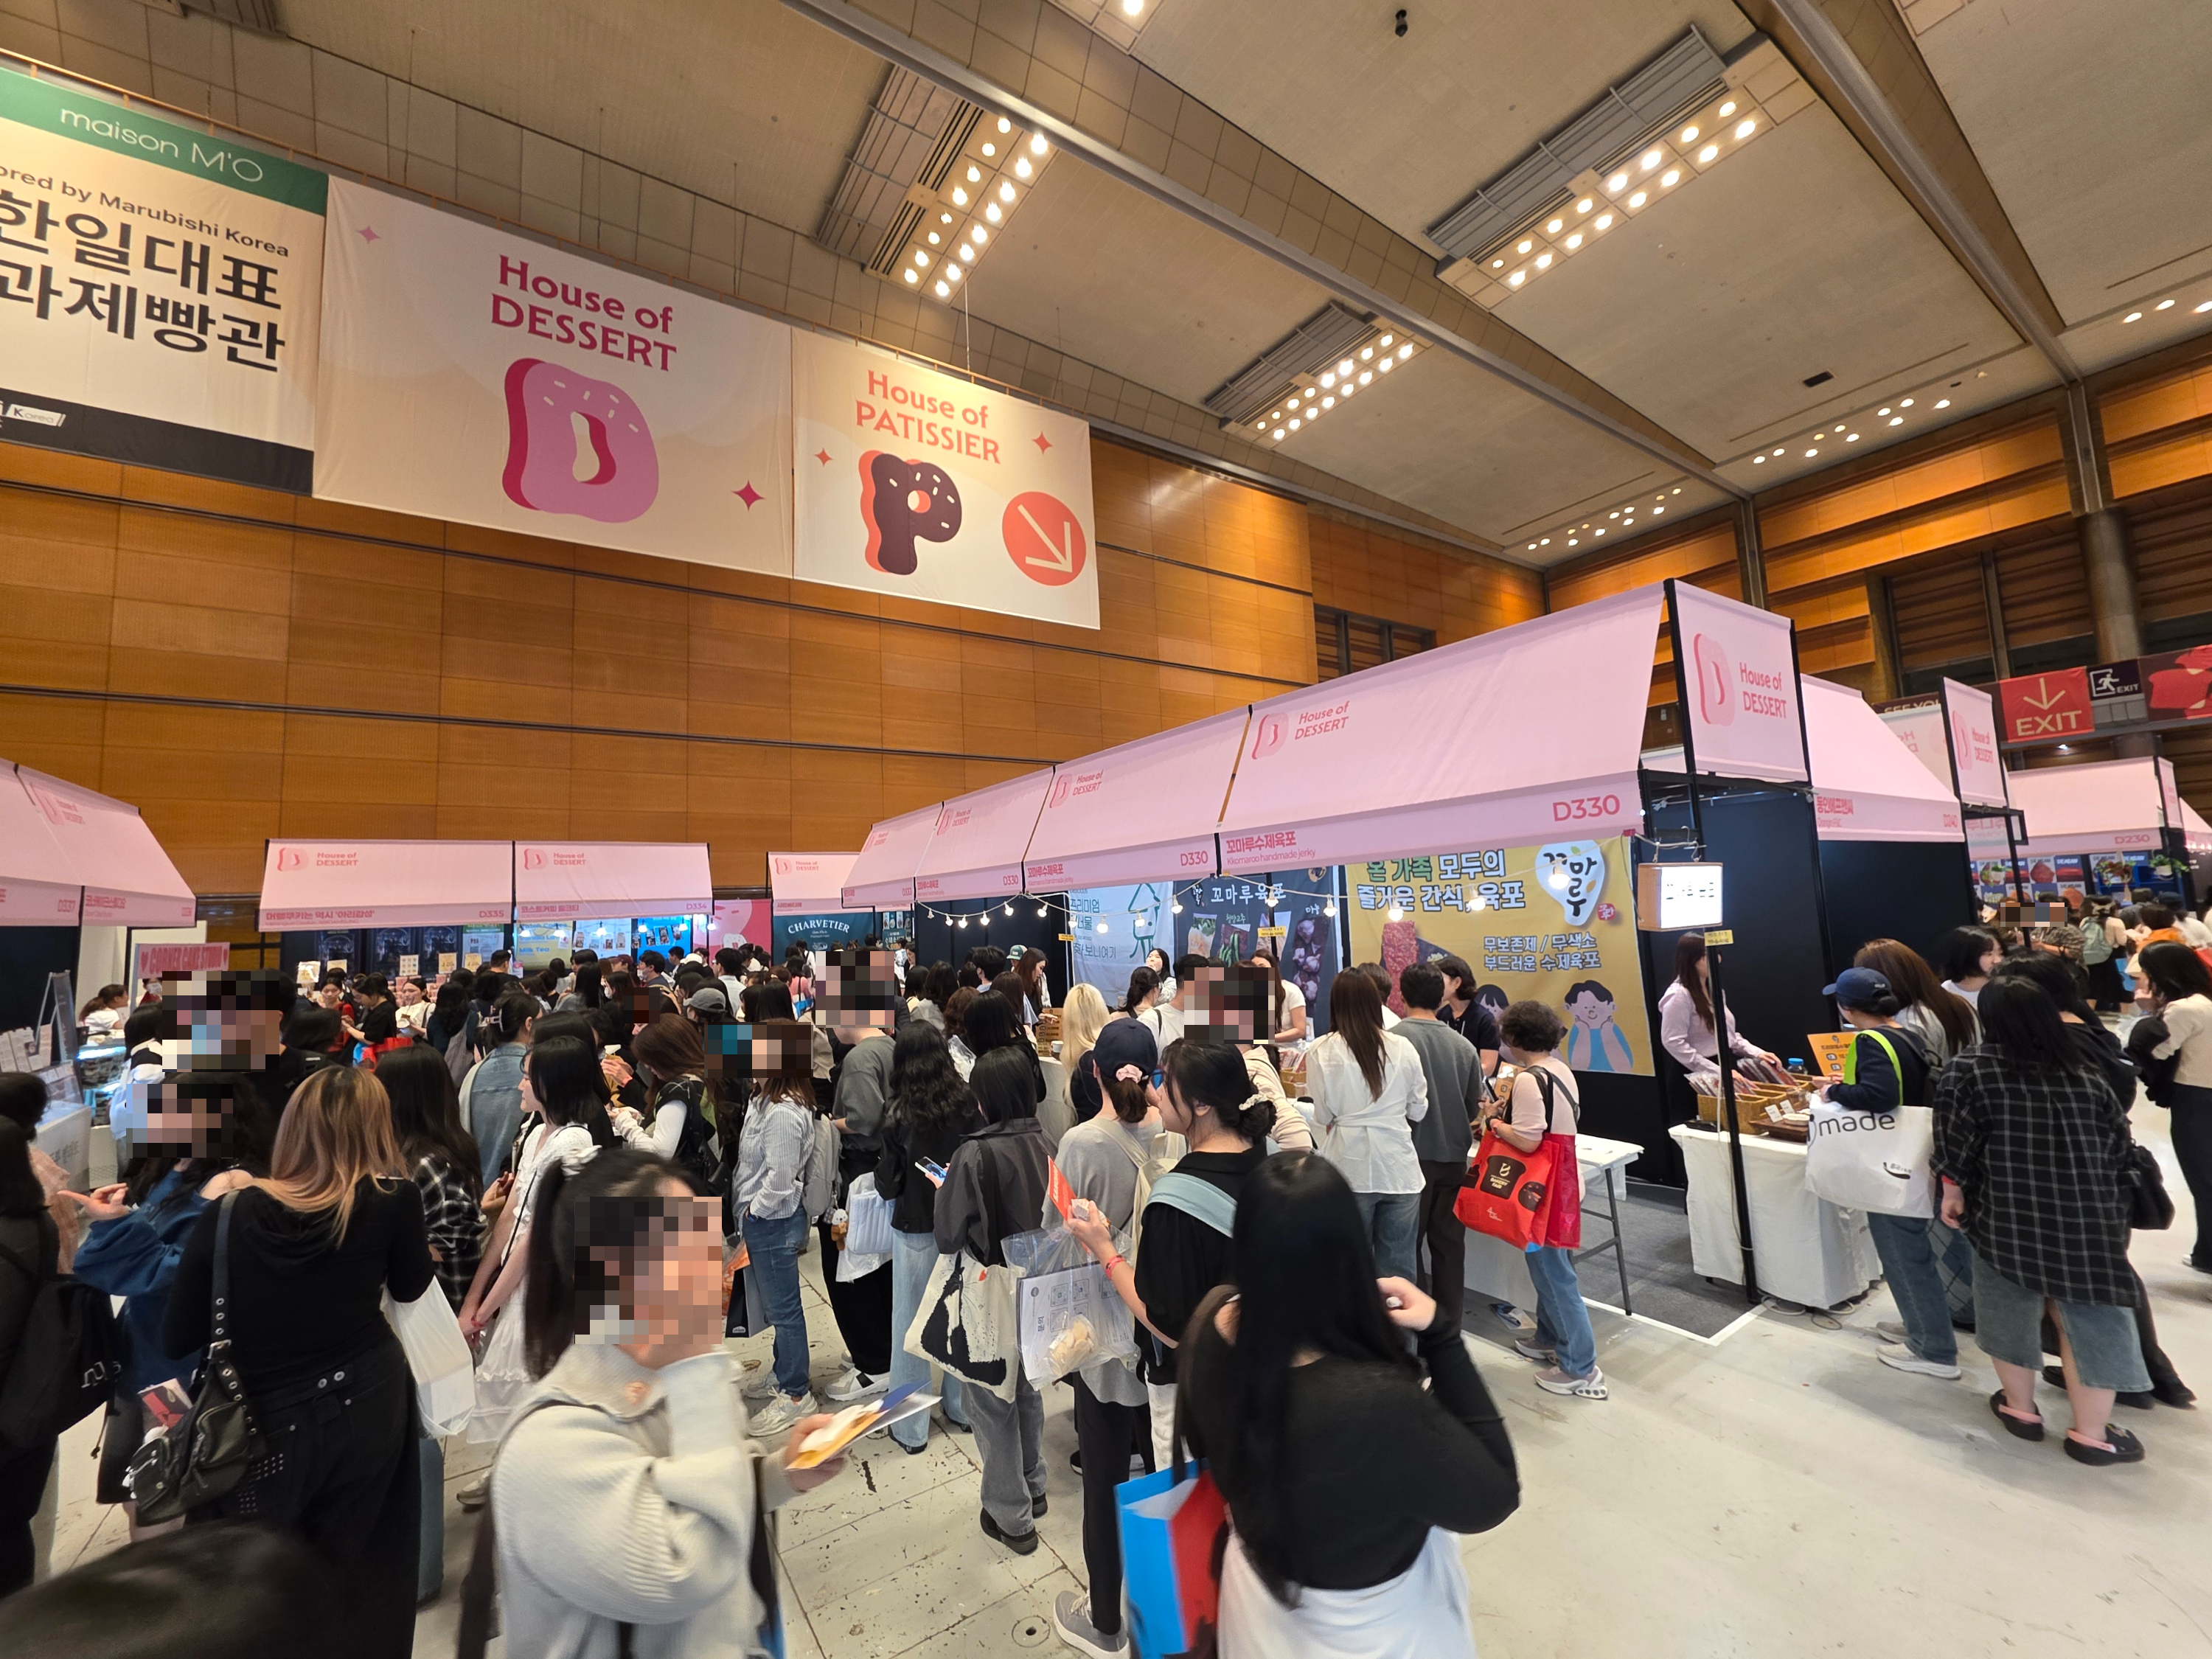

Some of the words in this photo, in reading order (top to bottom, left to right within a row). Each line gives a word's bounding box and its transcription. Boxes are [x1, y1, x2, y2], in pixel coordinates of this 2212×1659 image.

[60, 106, 179, 159] maison
[191, 142, 264, 183] M'O
[62, 170, 92, 204] by
[100, 177, 219, 237] Marubishi
[225, 227, 289, 257] Korea
[498, 255, 624, 321] House
[635, 307, 673, 334] of
[490, 293, 677, 372] DESSERT
[868, 370, 954, 421] House
[961, 403, 990, 428] of
[855, 400, 1001, 465] PATISSIER
[1739, 662, 1770, 688] House
[1773, 672, 1782, 691] of
[2117, 684, 2139, 692] EXIT
[1298, 706, 1333, 725] House
[1335, 700, 1350, 715] of
[1742, 691, 1787, 718] DESSERT
[1295, 716, 1349, 740] DESSERT
[2016, 710, 2082, 736] EXIT
[1077, 774, 1094, 784] House
[1096, 769, 1104, 779] of
[1073, 782, 1102, 796] DESSERT
[1552, 794, 1621, 821] D330
[1226, 831, 1296, 853] 꼬마루수제육포
[2115, 834, 2150, 844] D230
[1180, 851, 1208, 866] D330
[1227, 854, 1259, 866] Kkomaroo
[1259, 850, 1297, 862] handmade
[1297, 848, 1316, 860] jerky
[1392, 856, 1432, 882] 가족
[1438, 849, 1506, 880] 모두의
[1003, 874, 1018, 886] D330
[1028, 863, 1063, 878] 꼬마루수제육포
[1071, 899, 1099, 913] 프리미엄
[1357, 885, 1415, 912] 즐거운
[1476, 880, 1525, 910] 육포
[788, 919, 850, 934] CHARVETIER
[1484, 935, 1536, 953] 무보존제
[1551, 932, 1596, 950] 무색소
[1484, 955, 1537, 972] 부드러운
[1541, 952, 1601, 971] 수제육포
